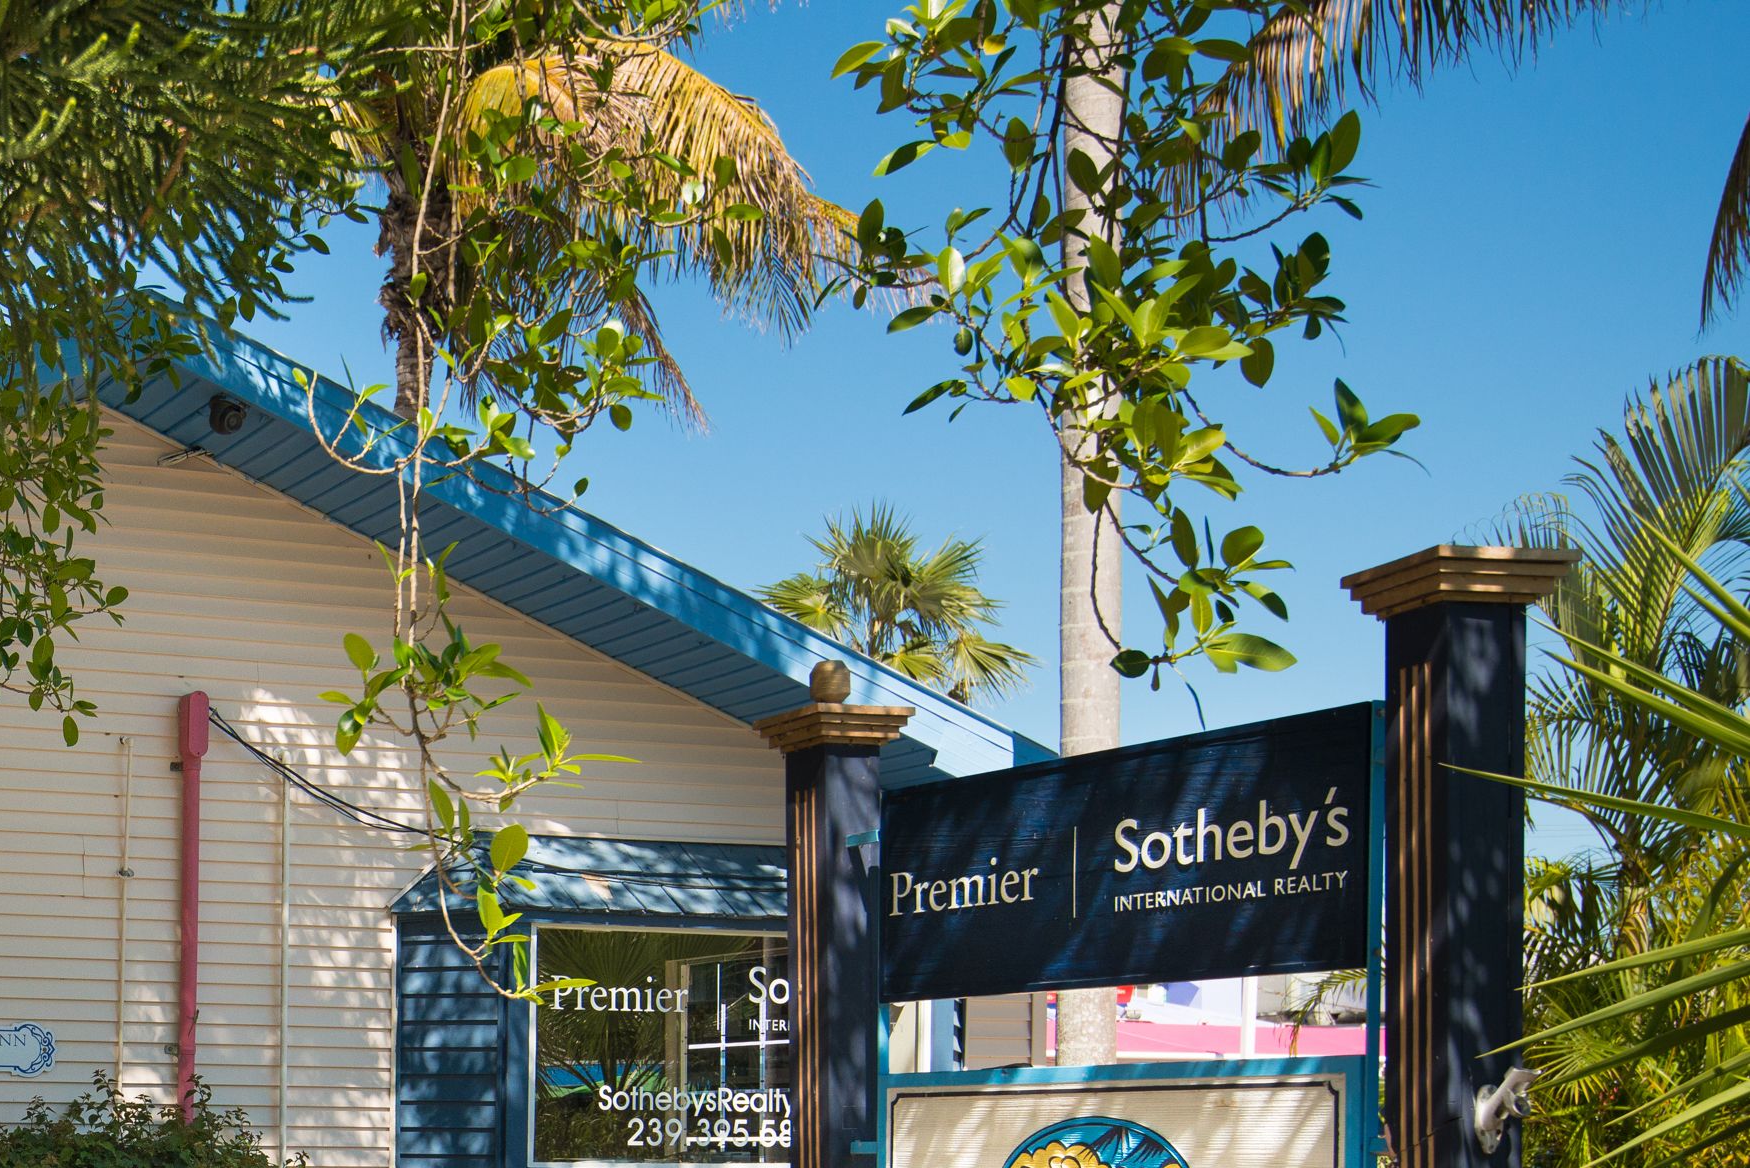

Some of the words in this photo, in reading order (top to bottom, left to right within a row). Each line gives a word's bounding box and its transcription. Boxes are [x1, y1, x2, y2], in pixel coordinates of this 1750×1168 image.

[888, 857, 1039, 917] Premier
[1114, 787, 1349, 874] Sotheby's
[1114, 881, 1267, 913] INTERNATIONAL
[1274, 870, 1349, 896] REALTY
[549, 974, 688, 1013] Premier
[748, 1019, 791, 1032] INTER
